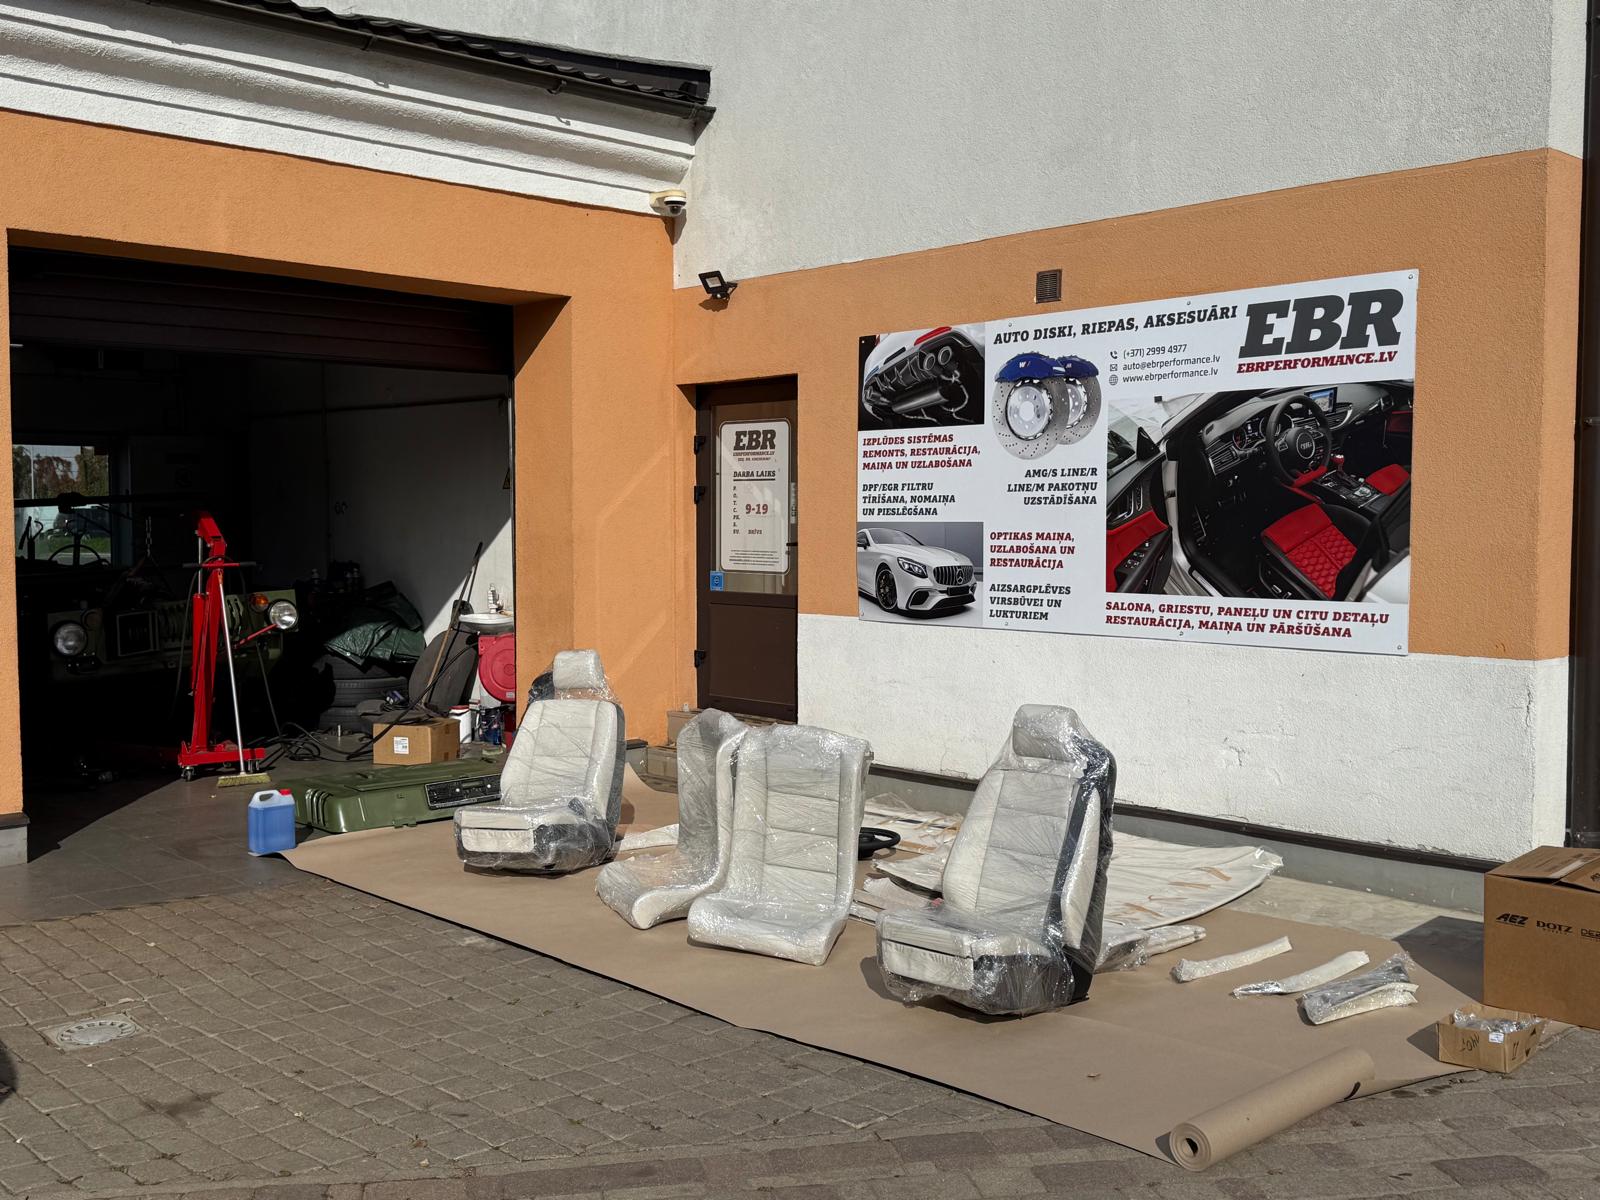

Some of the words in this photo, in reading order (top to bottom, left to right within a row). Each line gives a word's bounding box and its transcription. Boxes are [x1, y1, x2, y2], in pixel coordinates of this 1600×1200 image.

[993, 330, 1030, 345] AUTO
[1033, 325, 1077, 341] DISKI,
[1081, 317, 1139, 336] RIEPAS,
[1144, 305, 1238, 329] AKSESUĀRI
[1238, 288, 1404, 359] EBR
[1123, 348, 1145, 359] (+371)
[1146, 346, 1166, 356] 2999
[1167, 344, 1188, 354] 4977
[1122, 354, 1221, 371] auto@ebrperformance.lv
[1236, 350, 1399, 374] EBRPERFORMANCE.LV
[1122, 367, 1218, 382] www.ebrperformance.lv
[733, 429, 776, 450] EBR
[862, 436, 905, 446] IZPLŪDES
[862, 449, 908, 458] REMONTS,
[910, 445, 981, 456] RESTAURĀCIJA,
[862, 462, 893, 473] MAIŅA
[895, 461, 909, 469] UN
[911, 457, 973, 469] UZLABOŠANA
[1025, 469, 1058, 478] AMG/S
[1060, 467, 1098, 477] LINE/R
[862, 483, 899, 492] DPF/EGR
[901, 482, 934, 491] FILTRU
[1007, 483, 1045, 493] LINE/M
[1047, 482, 1098, 494] PAKOTŅU
[862, 494, 908, 504] TĪRĪŠANA,
[909, 494, 956, 506] NOMAIŅA
[1023, 494, 1097, 505] UZSTĀDĪŠANA
[745, 503, 769, 515] 9-19
[862, 508, 875, 516] UN
[877, 506, 938, 516] PIESLĒGŠANA
[990, 532, 1033, 541] OPTIKAS
[1035, 532, 1075, 545] MAIŅA,
[990, 543, 1057, 554] UZLABOŠANA
[1059, 545, 1075, 555] UN
[990, 556, 1064, 570] RESTAURĀCIJA
[989, 583, 1072, 595] AIZSARGPLĒVES
[989, 596, 1044, 607] VIRSBŪVEI
[1046, 599, 1062, 608] UN
[989, 609, 1049, 621] LUKTURIEM
[1105, 601, 1155, 614] SALONA,
[1158, 604, 1214, 616] GRIESTU,
[1217, 606, 1269, 621] PANEĻU
[1272, 608, 1292, 619] UN
[1296, 610, 1329, 620] CITU
[1332, 611, 1390, 628] DETAĻU
[1105, 615, 1195, 630] RESTAURĀCIJA,
[1198, 620, 1243, 634] MAIŅA
[1246, 622, 1266, 633] UN
[1269, 622, 1352, 638] PĀRŠŪŠANA
[1496, 913, 1529, 925] AEZ
[1536, 920, 1573, 934] DOTZ
